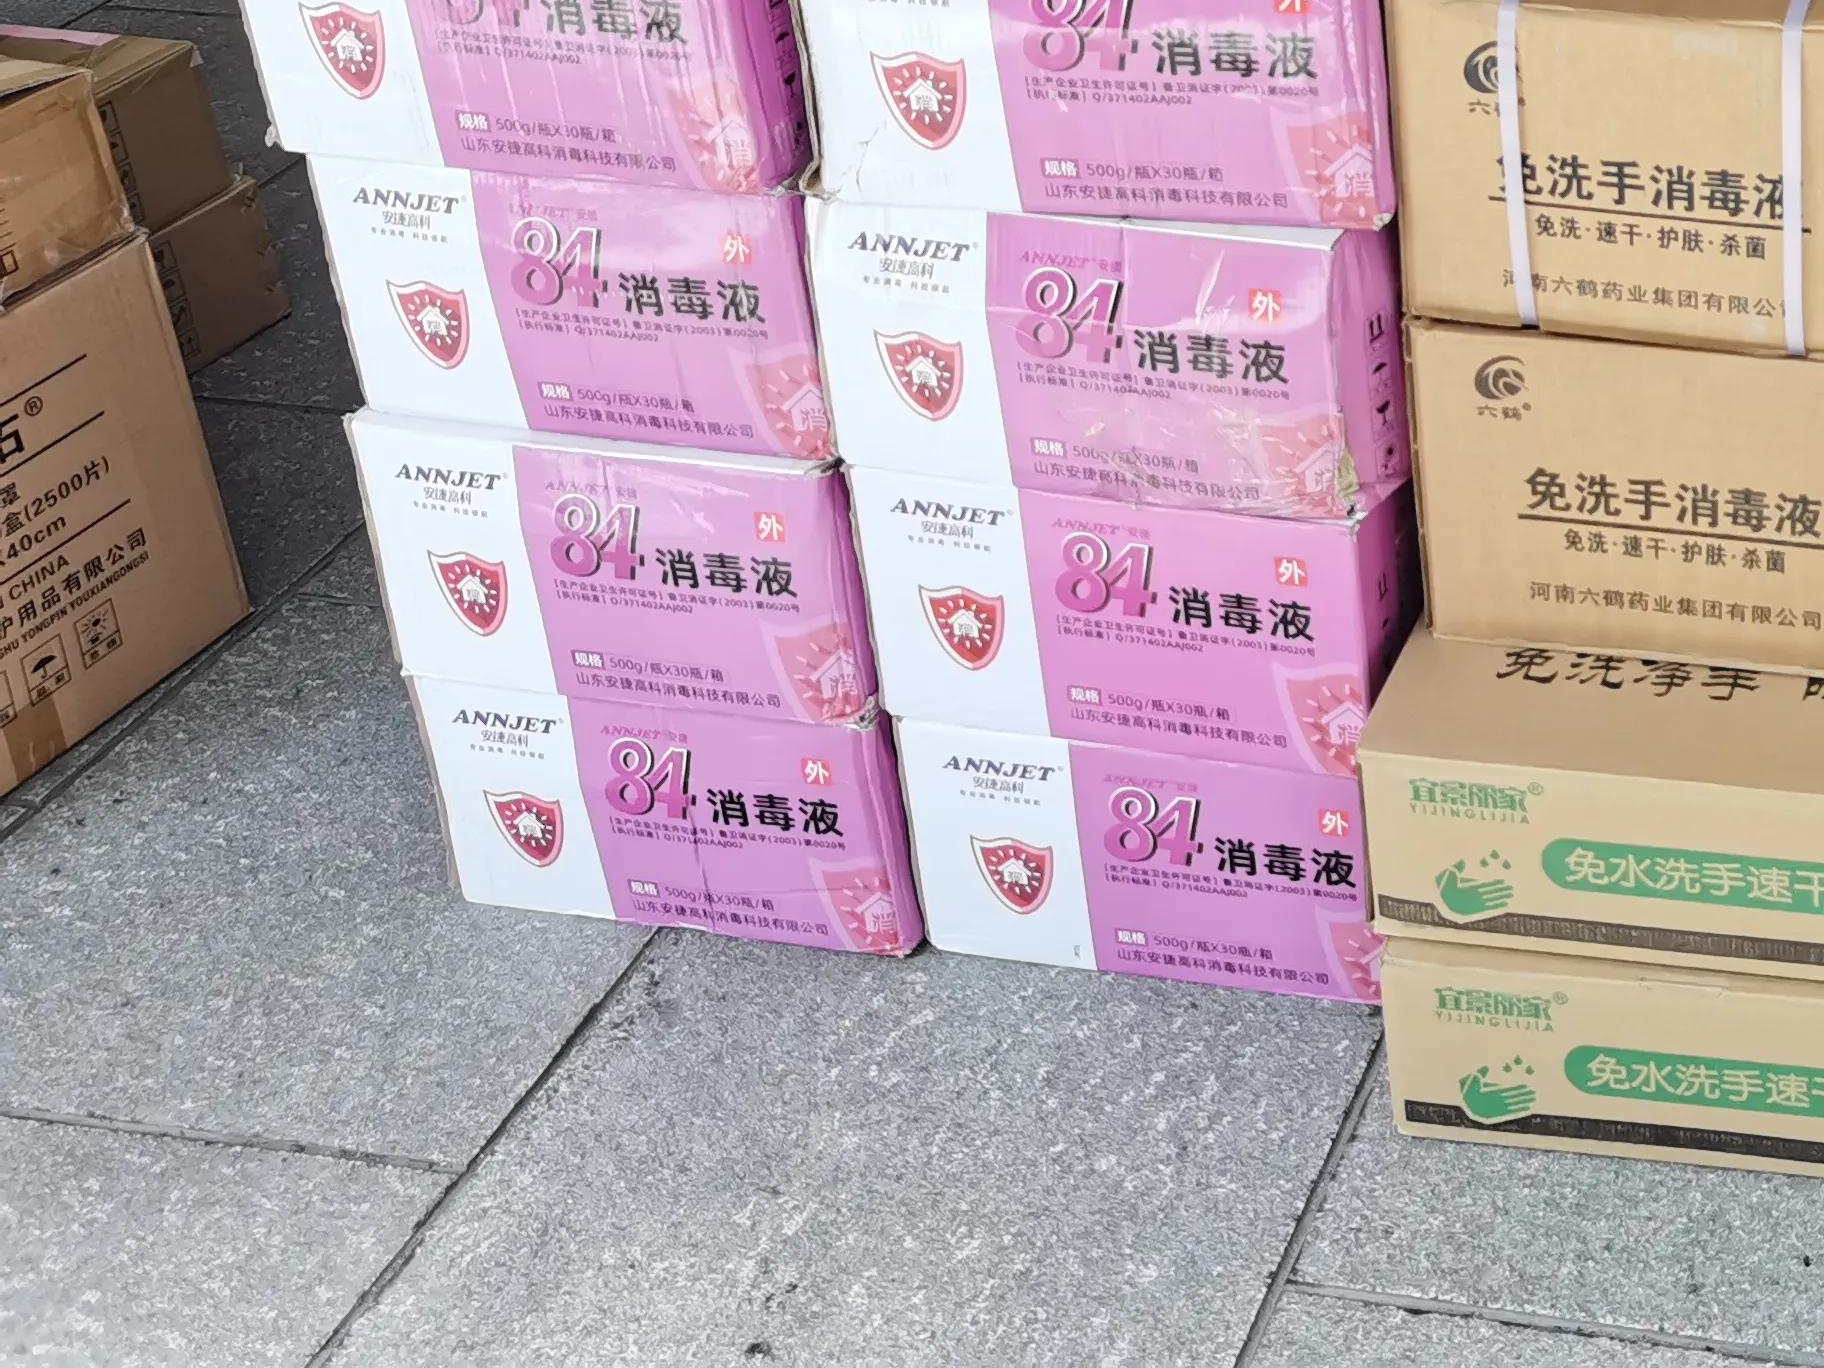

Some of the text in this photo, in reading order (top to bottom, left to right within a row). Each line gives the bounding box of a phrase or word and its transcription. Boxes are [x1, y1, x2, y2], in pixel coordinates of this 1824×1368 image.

[1152, 29, 1319, 80] 消毒液
[456, 112, 490, 131] 规格
[1044, 158, 1078, 178] 规格
[353, 186, 459, 215] ANNJET
[1495, 152, 1804, 221] 免洗手消毒液
[724, 235, 750, 264] 外
[847, 231, 970, 263] ANNJET
[510, 217, 766, 325] 84 消毒液
[1250, 291, 1281, 321] 外
[1502, 267, 1791, 319] 南六鹤药业集团有限公
[1016, 267, 1291, 385] 84 消毒液
[540, 383, 571, 401] 规格
[1476, 404, 1523, 422] 六鹤
[1033, 440, 1065, 457] 规格
[395, 463, 501, 491] ANNJET
[890, 497, 1005, 526] ANNJET
[1524, 466, 1824, 539] 免洗手消毒液
[756, 513, 784, 541] 外
[550, 493, 799, 599] 84 消毒液
[9, 554, 69, 602] CHINA
[1278, 558, 1306, 585] 外
[1054, 531, 1316, 643] 84 消毒液
[1530, 580, 1824, 631] 河南六鹤药业集团有限公司
[574, 650, 603, 668] 规格
[1495, 646, 1763, 703] 免洗净手
[1070, 686, 1100, 703] 规格
[451, 709, 557, 734] ANNJET
[804, 759, 830, 784] 外
[942, 755, 1056, 781] ANNJET
[605, 737, 845, 838] 84 消毒液
[1408, 777, 1530, 814] 宜景丽家
[1320, 811, 1348, 836] 外
[1408, 802, 1531, 825] YIJINGLIJIA
[1103, 785, 1358, 889] 84 消毒液
[630, 880, 658, 896] 规格
[1117, 930, 1147, 946] 规格
[1433, 986, 1553, 1023] 宜景丽家
[1433, 1009, 1556, 1033] YIJINGLIJIA
